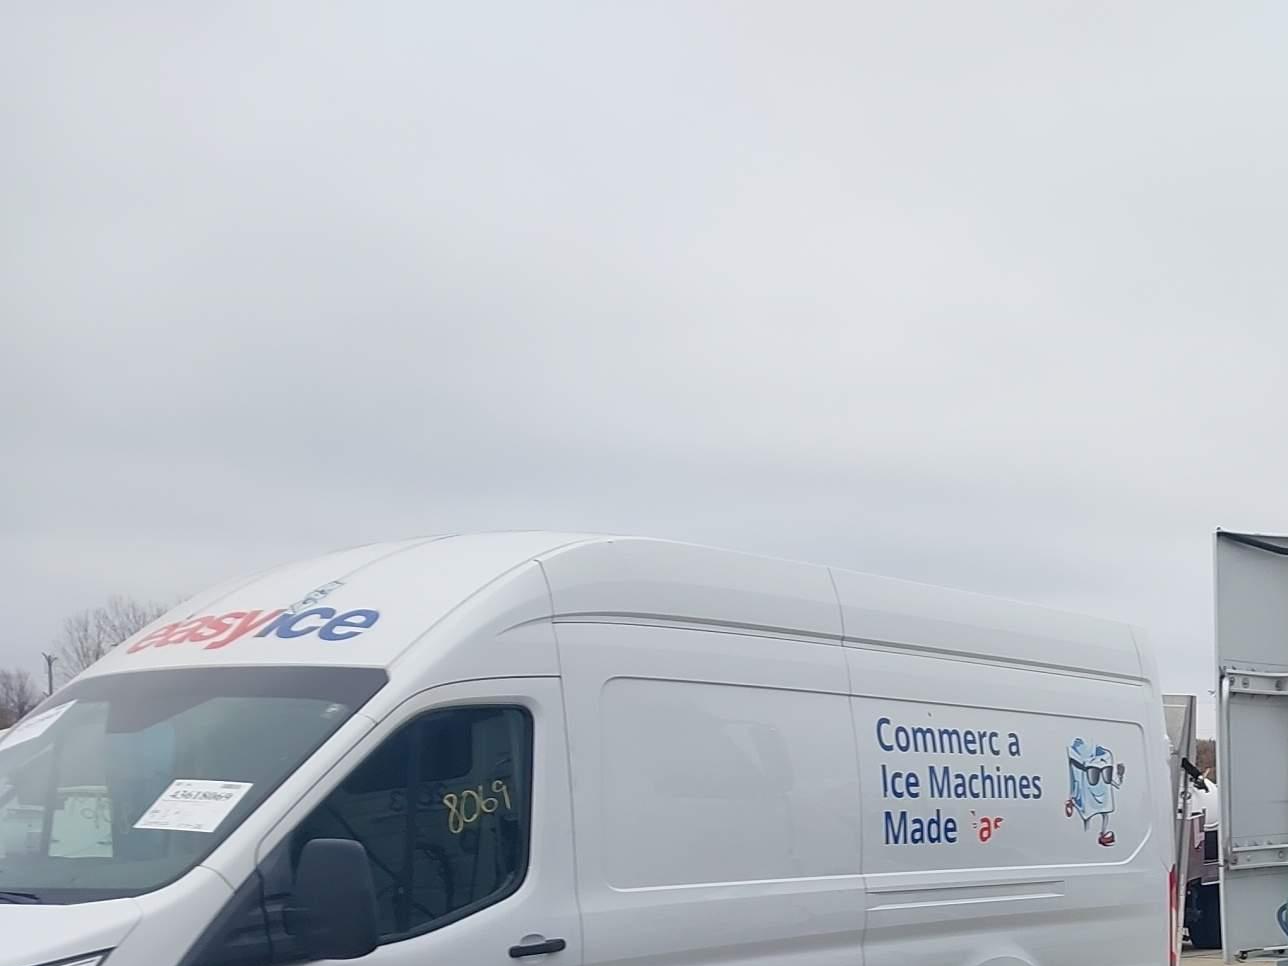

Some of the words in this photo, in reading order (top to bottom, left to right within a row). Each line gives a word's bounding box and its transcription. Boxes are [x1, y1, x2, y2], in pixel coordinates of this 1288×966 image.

[881, 764, 920, 799] Ice
[928, 765, 1042, 799] Machines
[443, 780, 511, 833] 8069
[884, 809, 957, 845] Made
